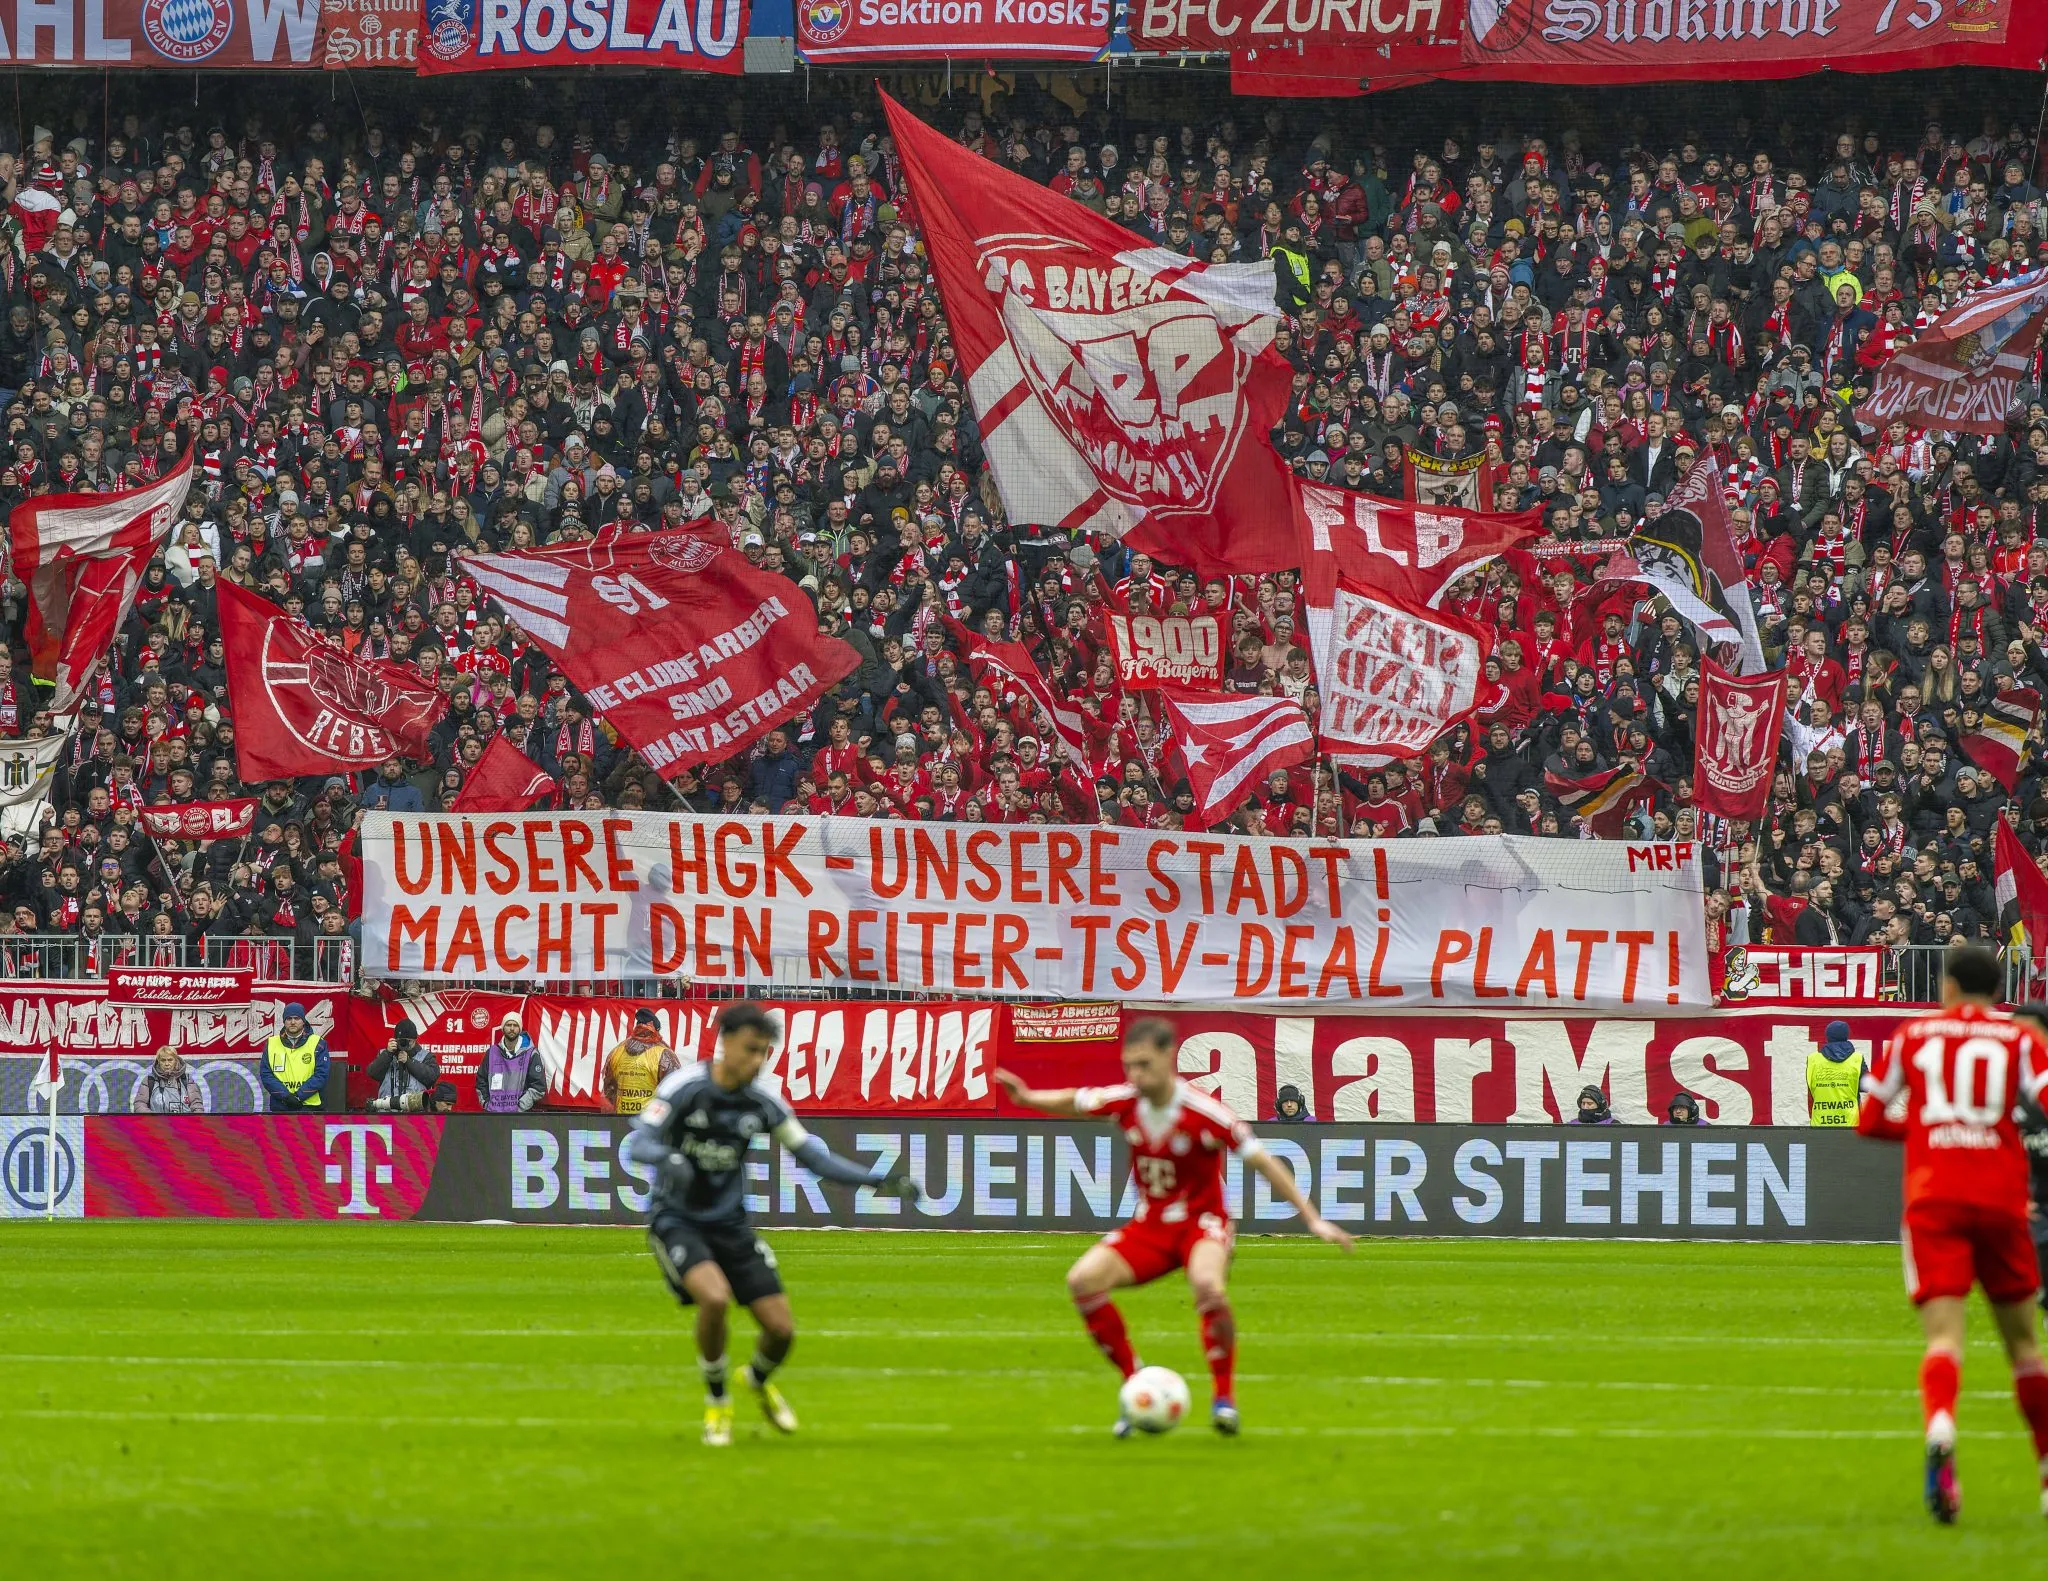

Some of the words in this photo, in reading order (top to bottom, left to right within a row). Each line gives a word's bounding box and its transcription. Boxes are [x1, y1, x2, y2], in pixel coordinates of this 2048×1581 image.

[479, 0, 740, 57] ROSLAU
[807, 26, 844, 40] KIOSK
[859, 0, 982, 26] Sektion
[995, 0, 1085, 25] Kiosk
[613, 596, 789, 700] CLUBFARBEN
[1110, 615, 1219, 666] 1900
[1153, 658, 1219, 685] Bayern
[668, 676, 733, 721] SIND
[393, 819, 640, 895] UNSERE
[669, 821, 813, 898] HGK
[870, 826, 1121, 907] UNSERE
[1145, 839, 1391, 921] STADT!
[387, 902, 620, 973] MACHT
[650, 904, 773, 978] DEN
[808, 909, 1404, 998] REITER-TSV-DEAL
[1431, 927, 1680, 1006] PLATT!
[446, 1017, 464, 1033] §1
[1014, 1008, 1059, 1019] NIEMALS
[1061, 1005, 1120, 1018] ABWESEND
[1015, 1026, 1052, 1037] IMMER
[1055, 1023, 1118, 1037] ANWESEND
[442, 1055, 464, 1064] SIND
[860, 1008, 993, 1103] PRIDE
[1913, 1036, 2009, 1126] 10
[1820, 1115, 1848, 1125] 1561
[1452, 1138, 1807, 1227] STEHEN
